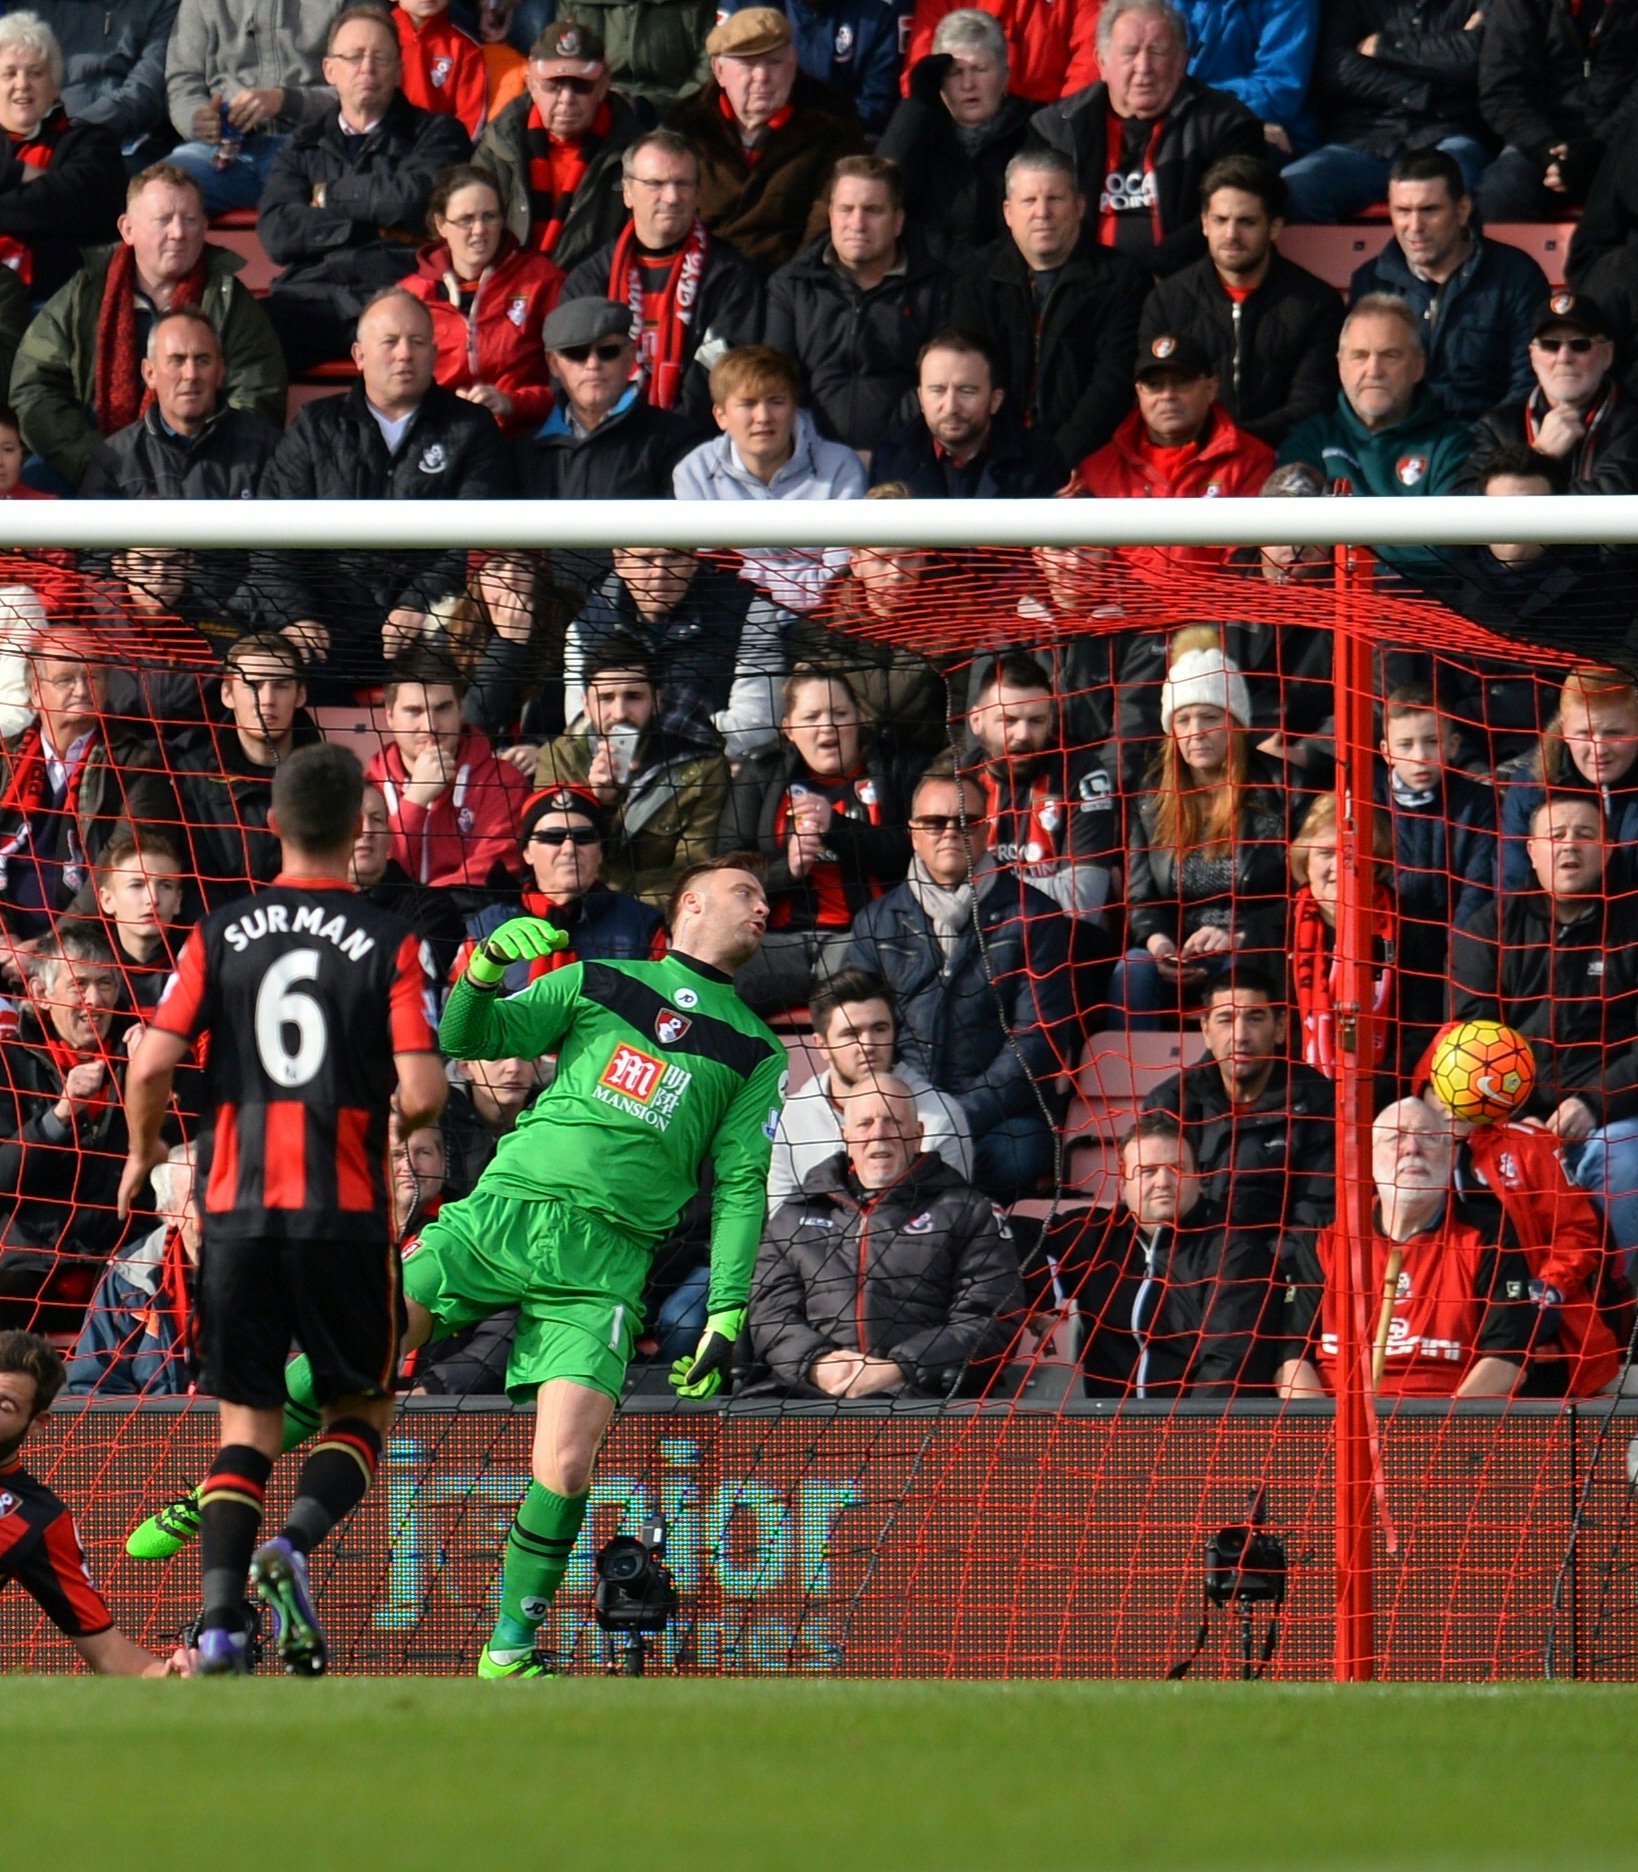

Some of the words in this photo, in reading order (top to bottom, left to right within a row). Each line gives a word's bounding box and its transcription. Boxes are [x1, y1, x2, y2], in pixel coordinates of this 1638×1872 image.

[1105, 170, 1158, 195] OCA
[224, 904, 376, 962] SURMAN
[255, 946, 328, 1088] 6
[591, 1084, 671, 1133] MANSION
[372, 1436, 862, 1630] jnior
